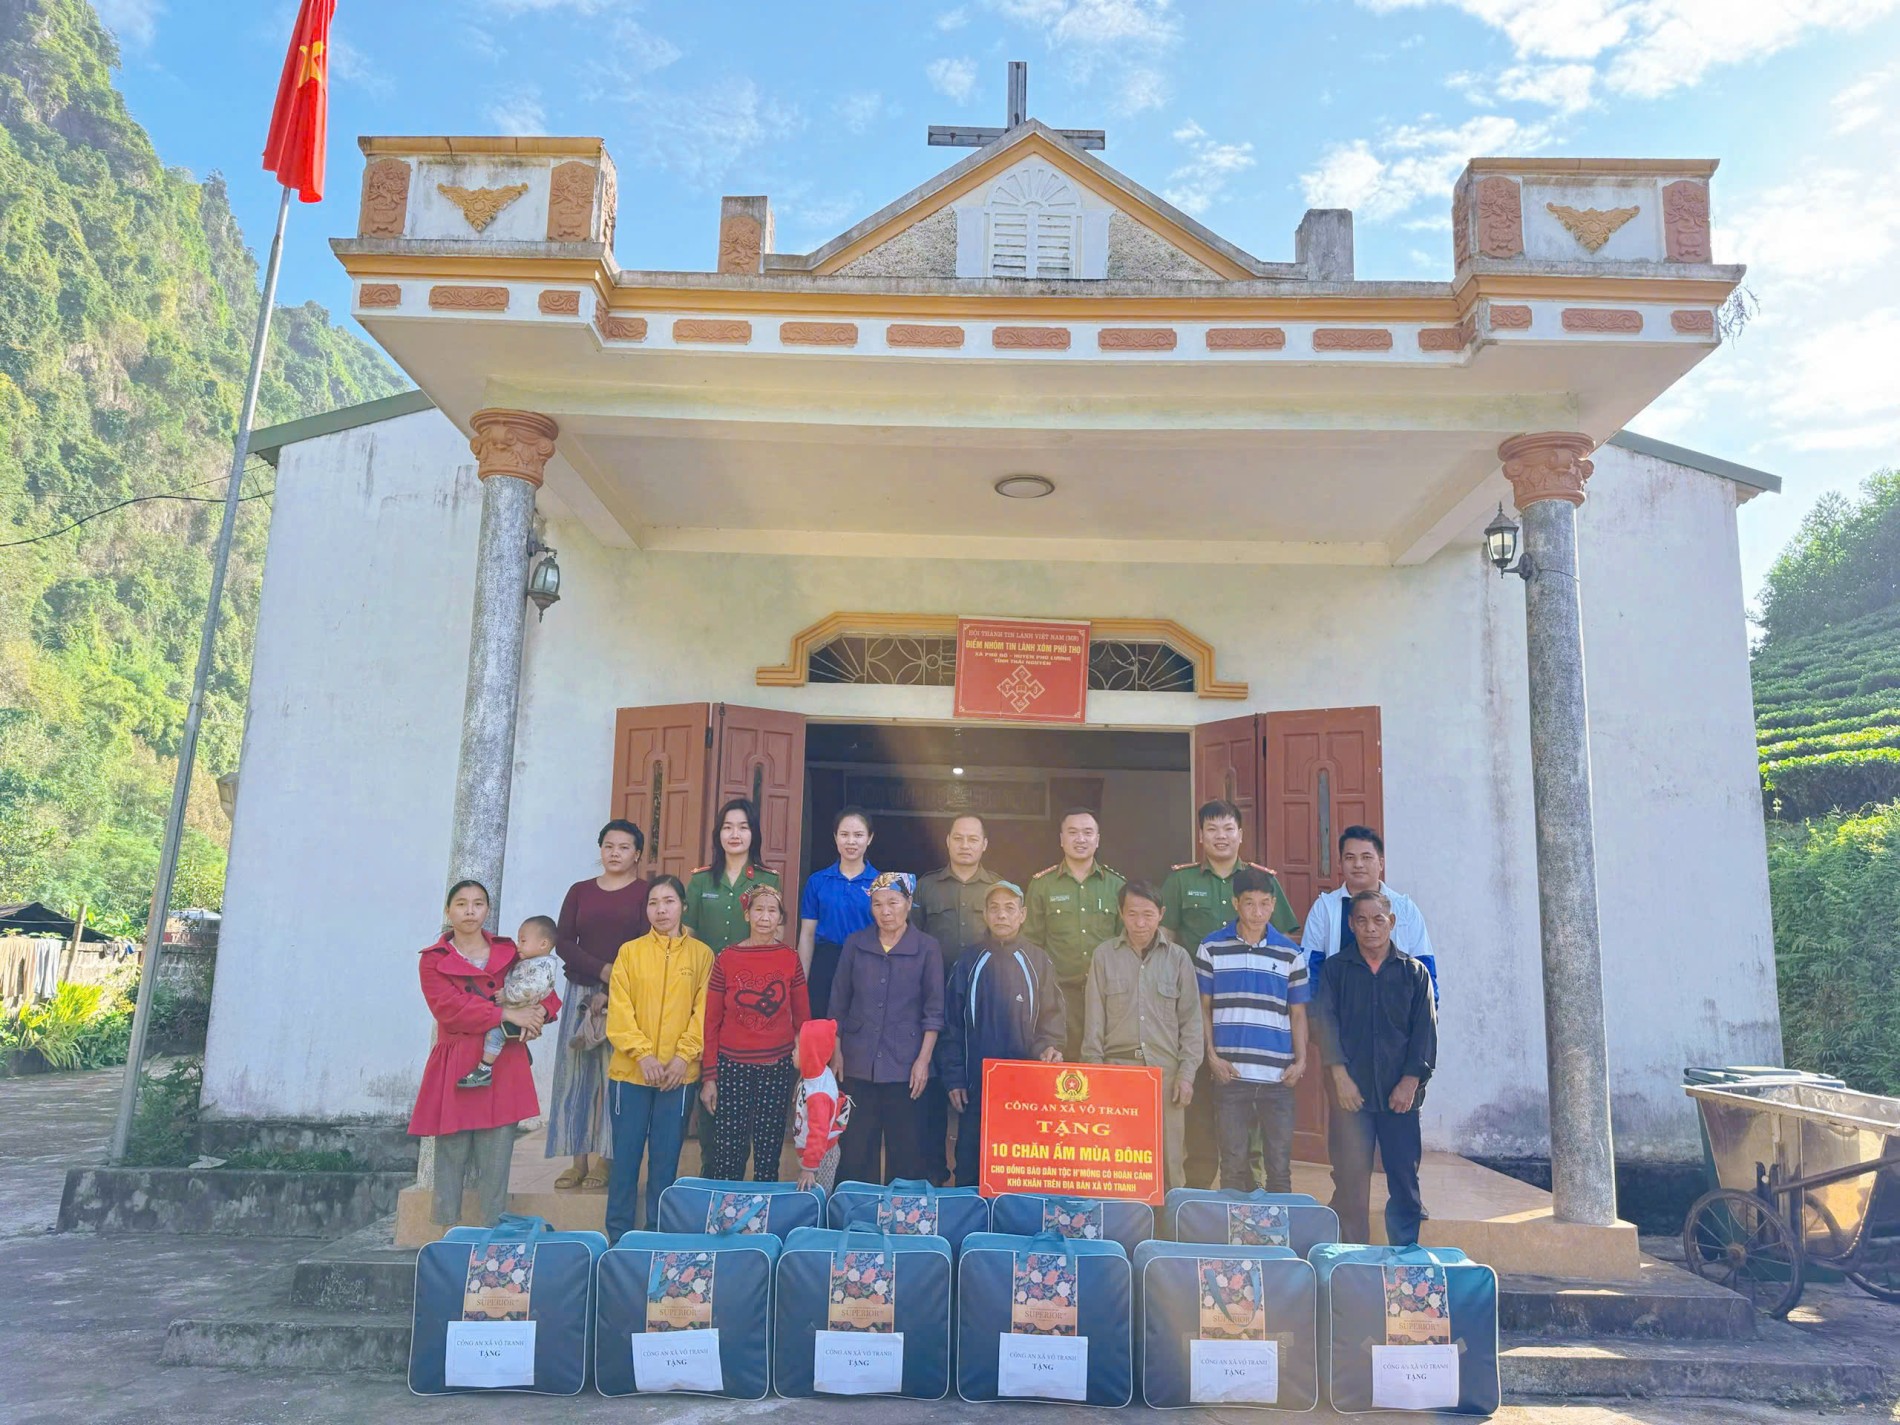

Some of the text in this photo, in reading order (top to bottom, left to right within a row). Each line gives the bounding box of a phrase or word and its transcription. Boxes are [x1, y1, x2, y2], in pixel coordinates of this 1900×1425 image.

[965, 637, 983, 649] ĐIỂM
[984, 639, 1004, 650] NHÓM
[1005, 642, 1017, 651] TIN
[1018, 641, 1036, 652] LÀNH
[1036, 642, 1052, 653] XÓM
[1053, 643, 1067, 653] PHÚ
[1005, 1101, 1139, 1116] CÔNG AN XÃ VÔ TRANH
[1036, 1119, 1111, 1137] TẶNG
[991, 1140, 1153, 1164] 10 CHĂN ẤM MÙA ĐÔNG
[990, 1165, 1005, 1174] CHO
[1006, 1163, 1025, 1175] ĐỒNG
[1026, 1165, 1041, 1175] BÀO
[1058, 1167, 1072, 1178] TỘC
[1102, 1168, 1111, 1178] CÓ
[1113, 1169, 1132, 1180] HOÀN
[1134, 1169, 1153, 1181] CẢNH
[1007, 1177, 1022, 1187] KHÓ
[1023, 1178, 1042, 1188] KHĂN
[1043, 1179, 1061, 1189] TRÊN
[1062, 1181, 1075, 1191] ĐỊA
[1092, 1180, 1102, 1190] XÃ
[1113, 1182, 1137, 1192] TRANH
[477, 1298, 515, 1306] SUPERIOR
[660, 1308, 697, 1316] SUPERIOR
[841, 1309, 879, 1317] SUPERIOR
[1025, 1310, 1063, 1319] SUPERIOR
[1399, 1322, 1436, 1330] SUPERIOR
[479, 1350, 501, 1358] TẶNG
[666, 1359, 687, 1367] TẶNG
[848, 1359, 870, 1367] TẶNG
[1032, 1363, 1054, 1371] TẶNG
[1224, 1369, 1246, 1377] TẶNG
[1406, 1373, 1427, 1381] TẶNG
